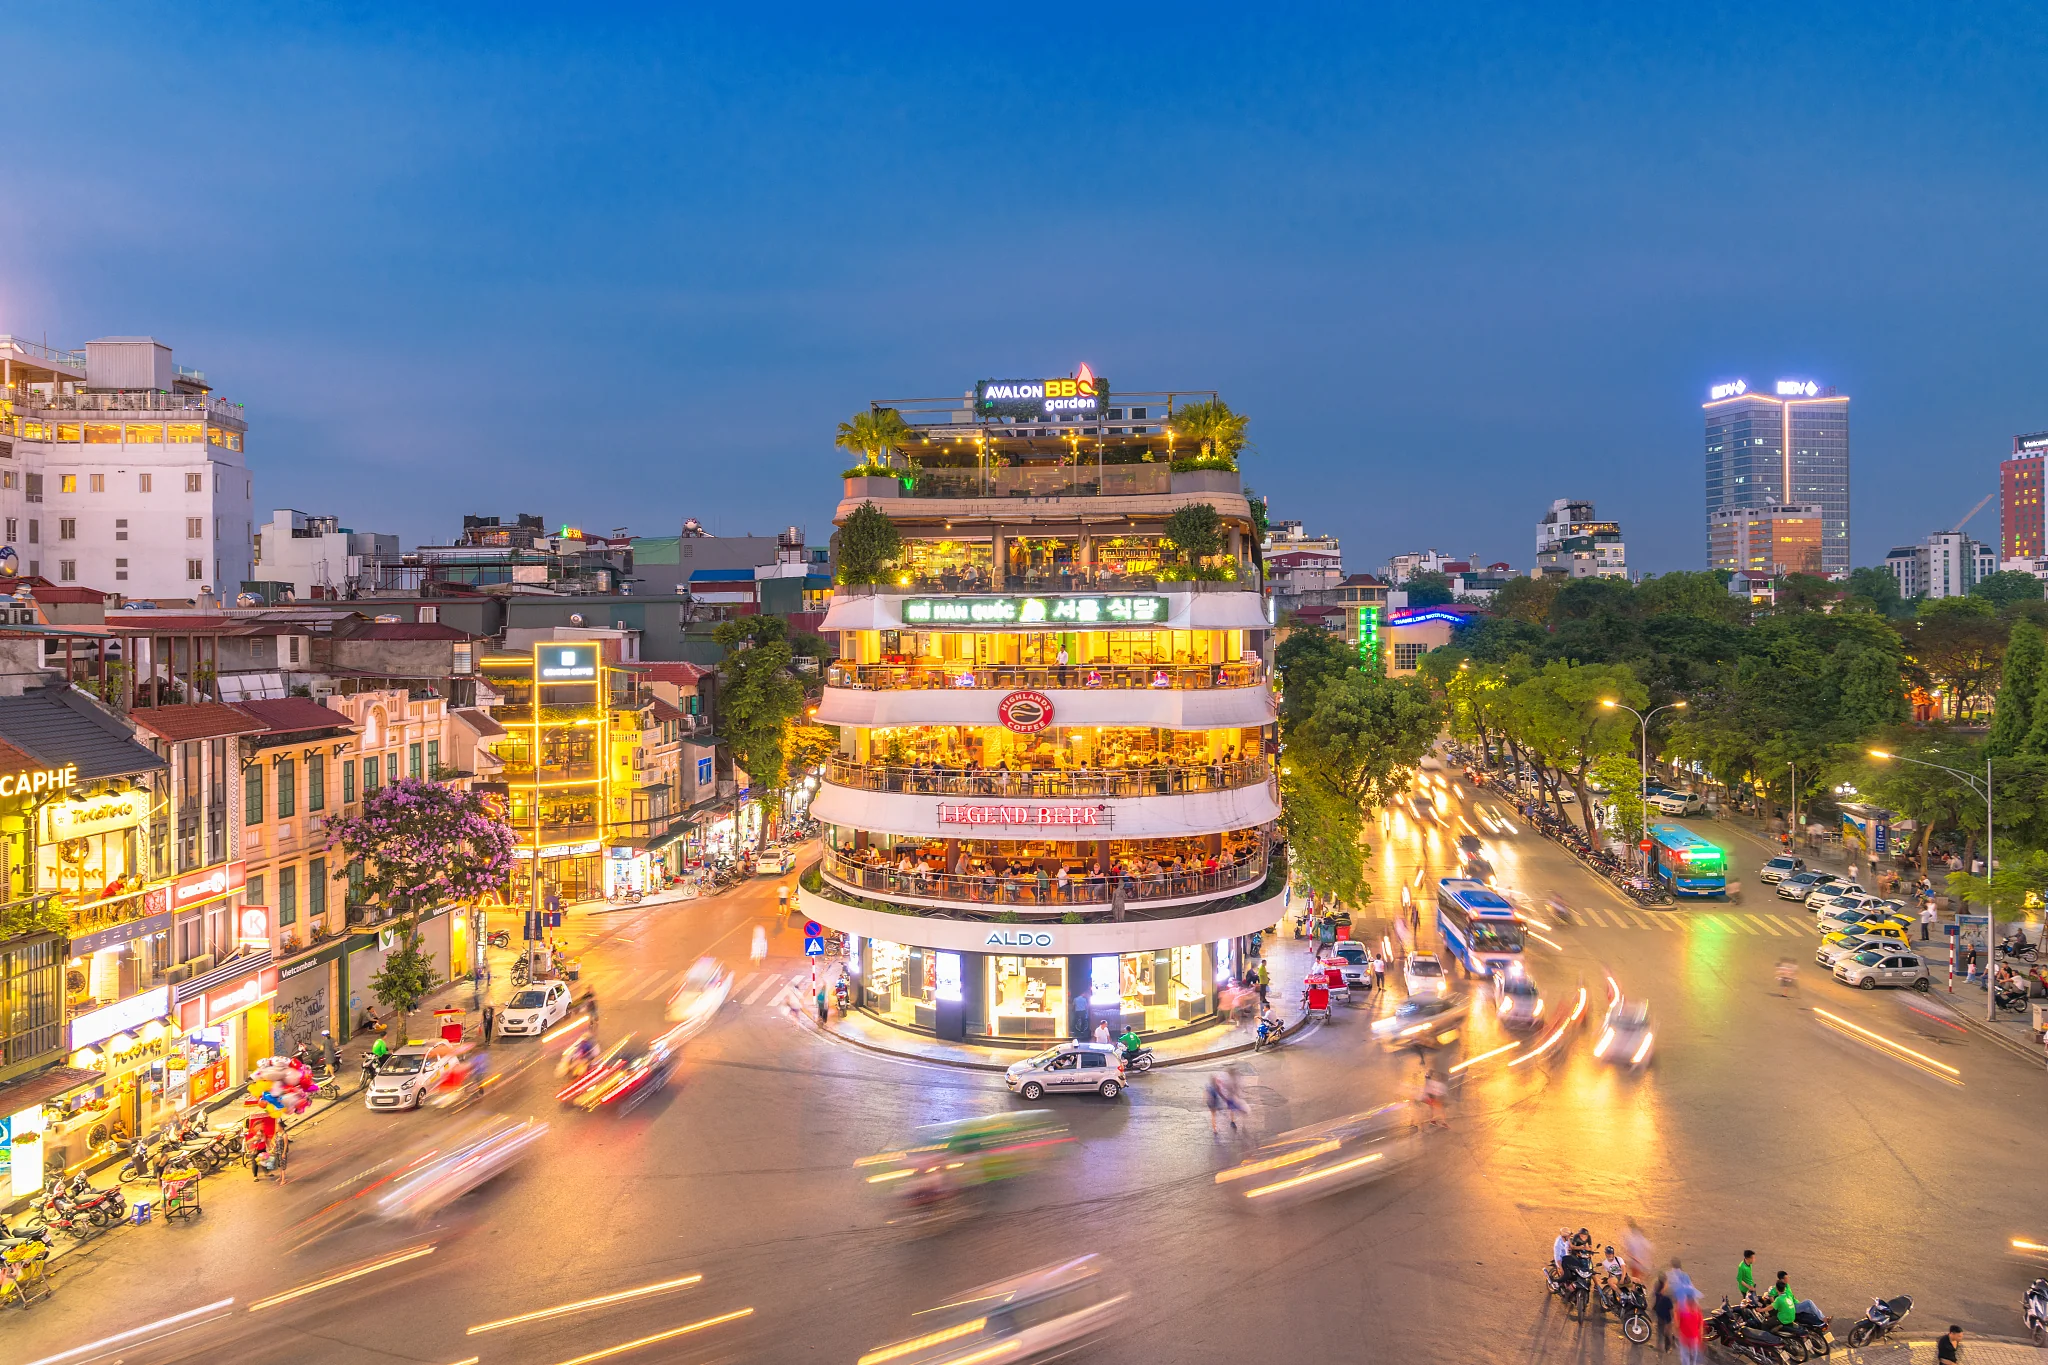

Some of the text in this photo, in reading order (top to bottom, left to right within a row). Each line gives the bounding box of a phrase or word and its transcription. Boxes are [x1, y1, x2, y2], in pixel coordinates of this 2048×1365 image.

[985, 381, 1099, 398] AVALON BBQ
[1045, 398, 1096, 411] garden
[1106, 598, 1159, 619] 식당
[1001, 693, 1051, 711] HIGHLANDS
[1007, 720, 1046, 731] COFFEE
[941, 804, 1097, 825] LEGEND BEER
[455, 908, 465, 917] ATM
[986, 932, 1052, 947] ALDO
[281, 957, 318, 979] Vietcombank
